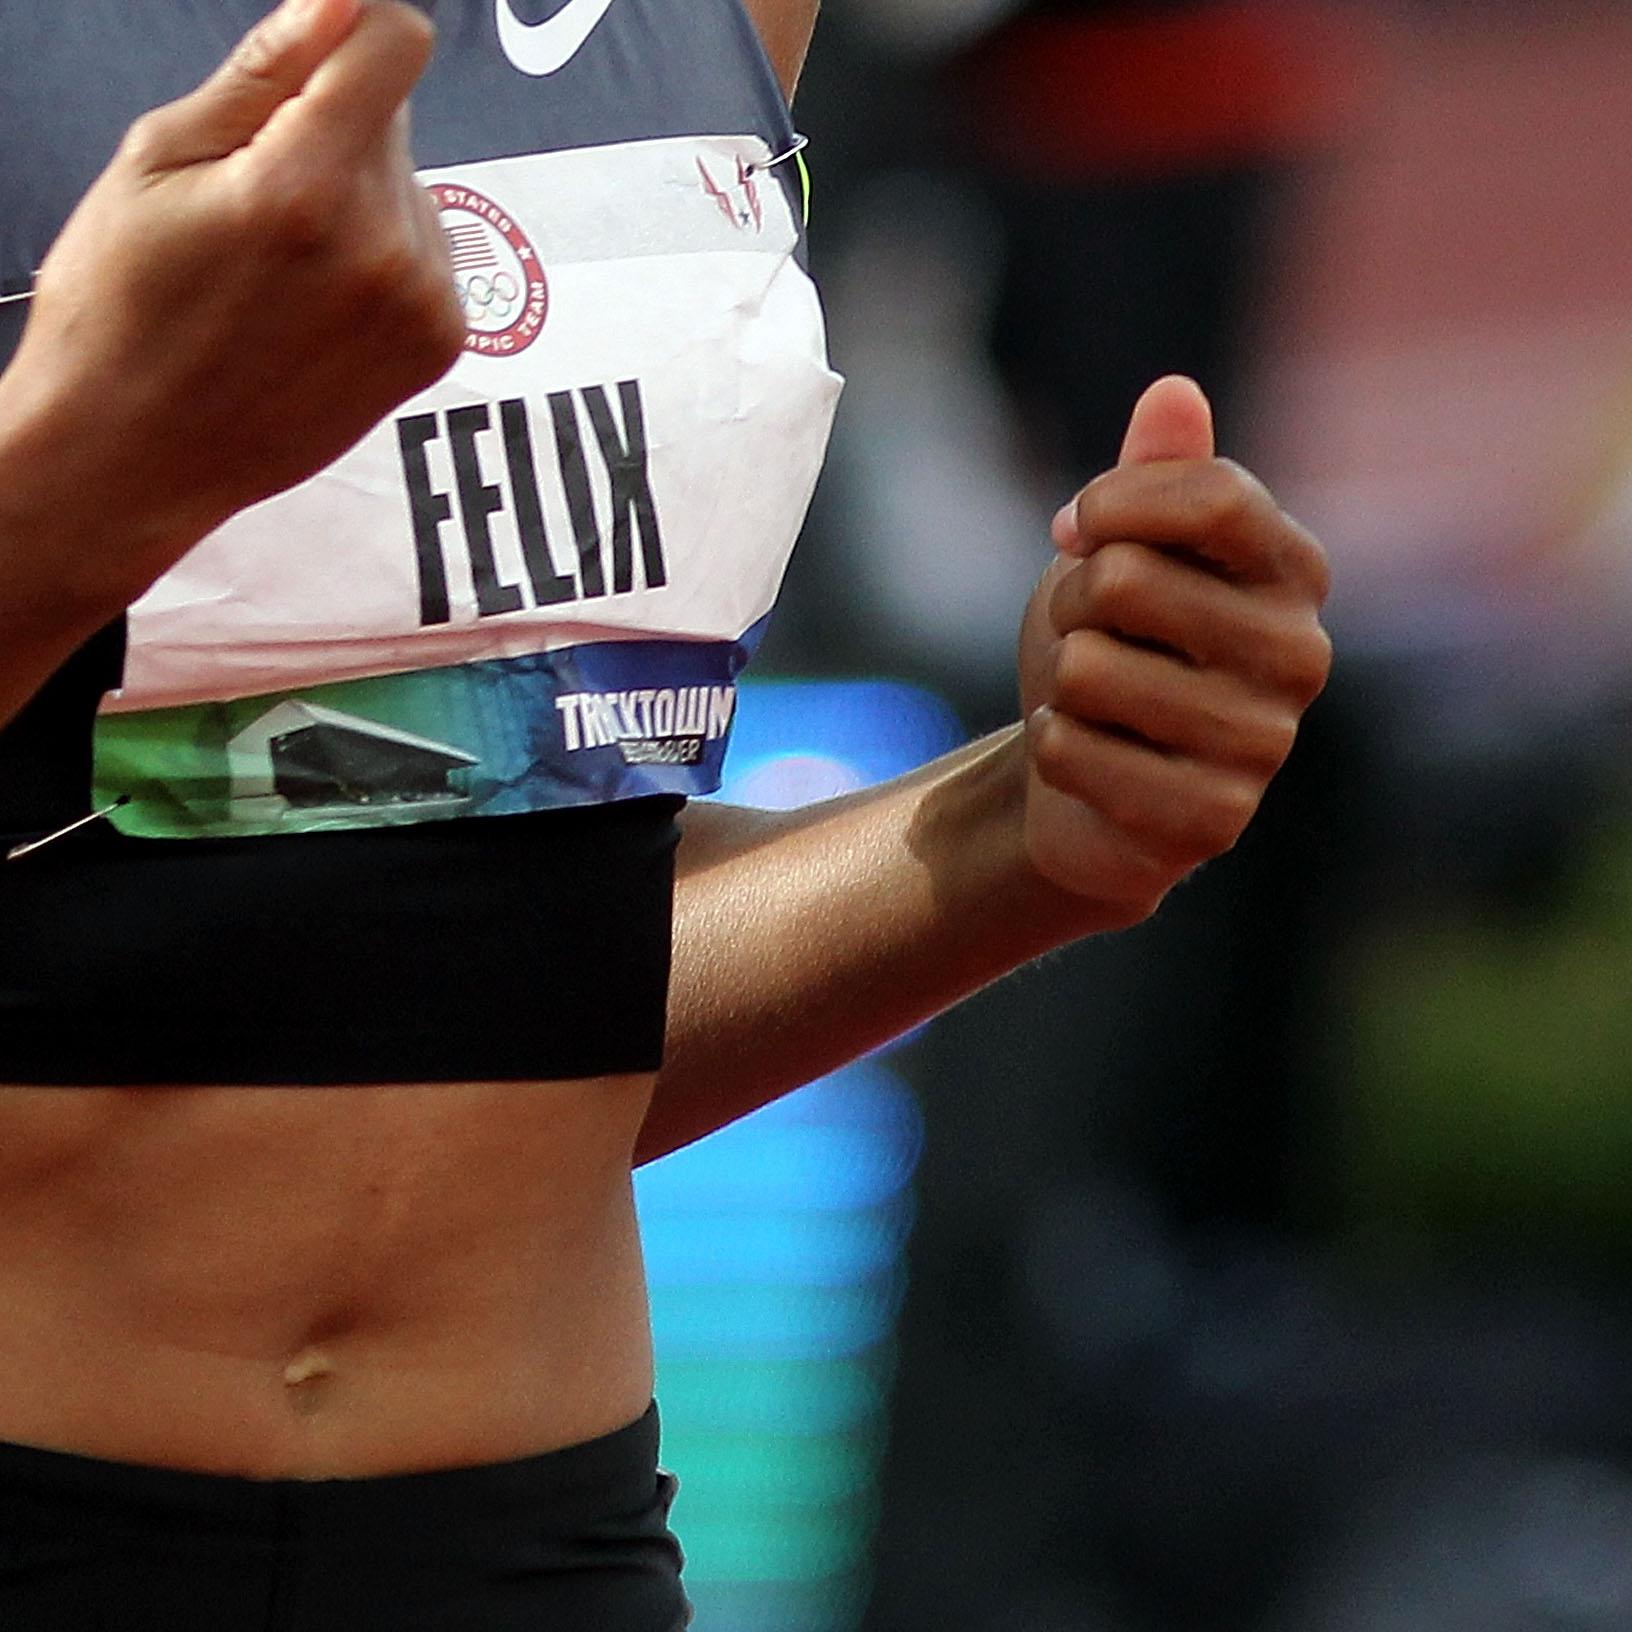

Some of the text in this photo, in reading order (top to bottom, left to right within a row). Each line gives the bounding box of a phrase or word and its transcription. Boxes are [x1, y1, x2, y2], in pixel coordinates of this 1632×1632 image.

[442, 189, 513, 233] STATES
[517, 281, 545, 336] TEAM
[396, 378, 667, 627] FELIX
